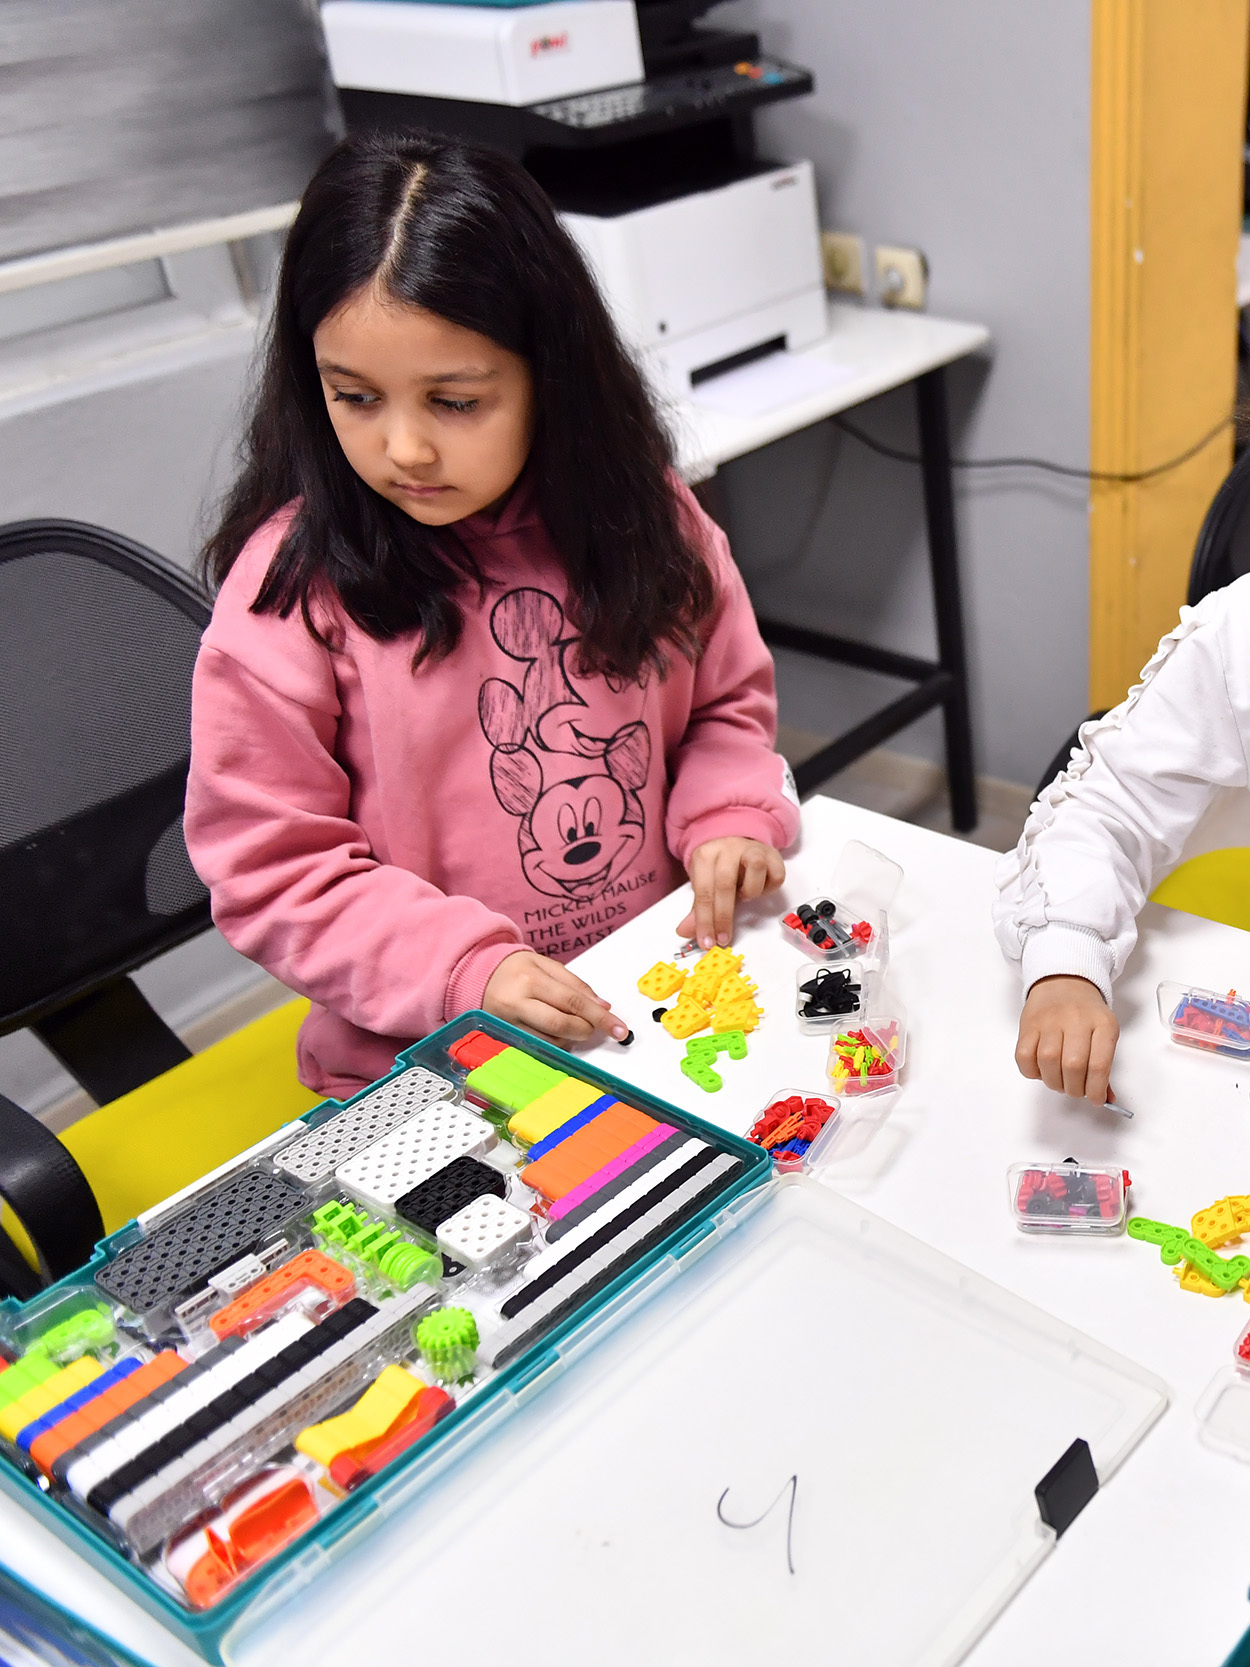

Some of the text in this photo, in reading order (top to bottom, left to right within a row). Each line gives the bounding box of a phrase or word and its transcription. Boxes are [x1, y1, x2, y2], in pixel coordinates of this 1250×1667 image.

[524, 870, 657, 925] MICKEY MAUSE
[527, 902, 627, 942] THE WILDS
